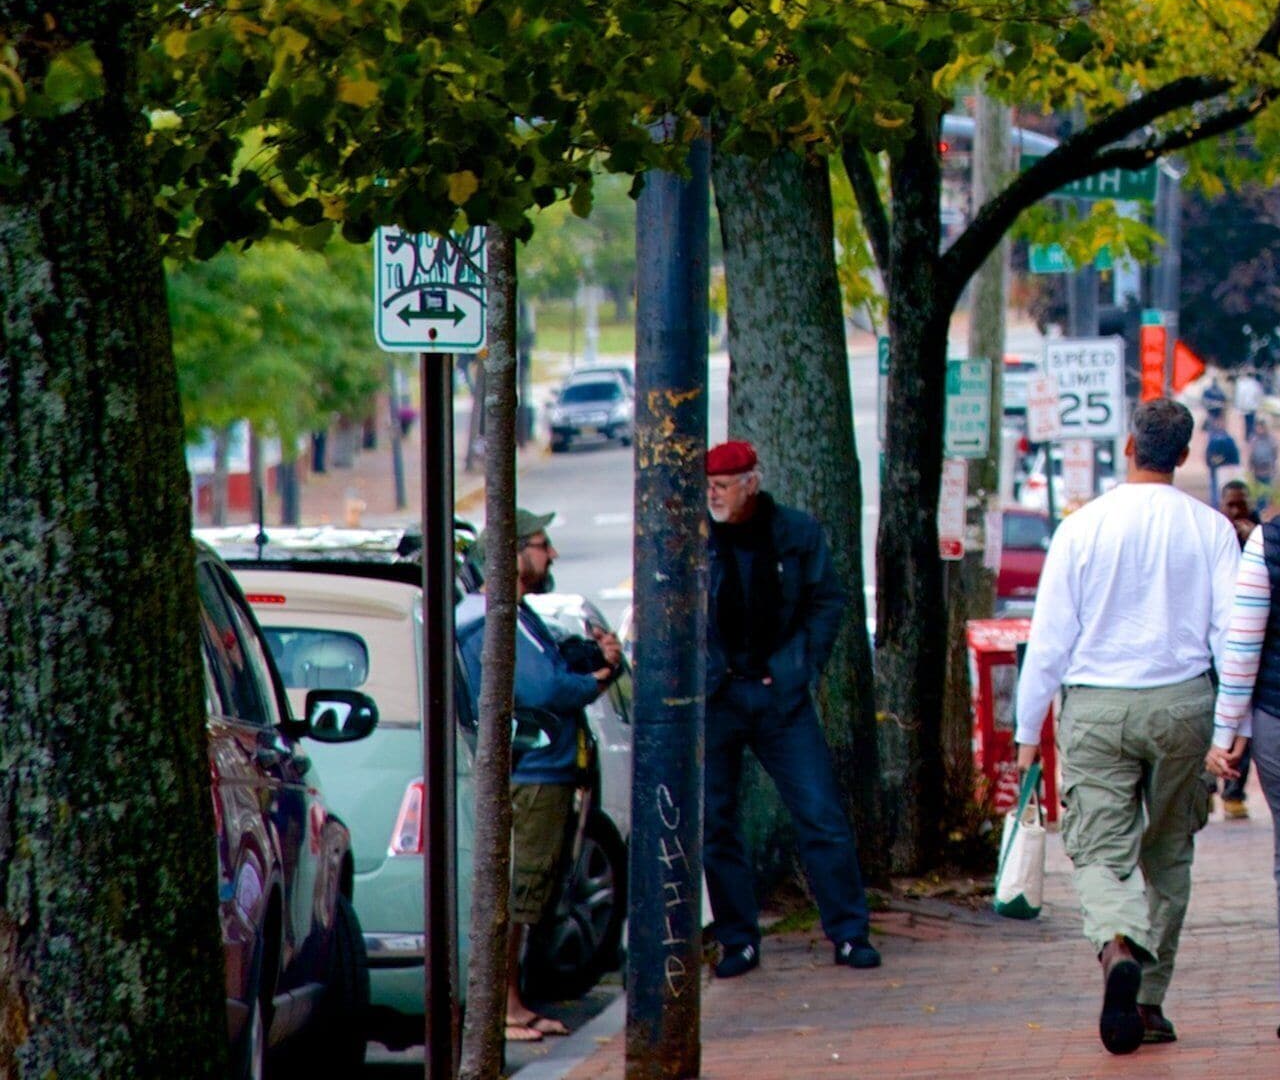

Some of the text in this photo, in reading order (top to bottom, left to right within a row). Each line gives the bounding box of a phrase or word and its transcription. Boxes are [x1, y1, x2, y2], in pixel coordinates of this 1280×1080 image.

[1053, 351, 1116, 369] SPEED
[1058, 371, 1107, 388] LIMIT
[1059, 392, 1112, 425] 25
